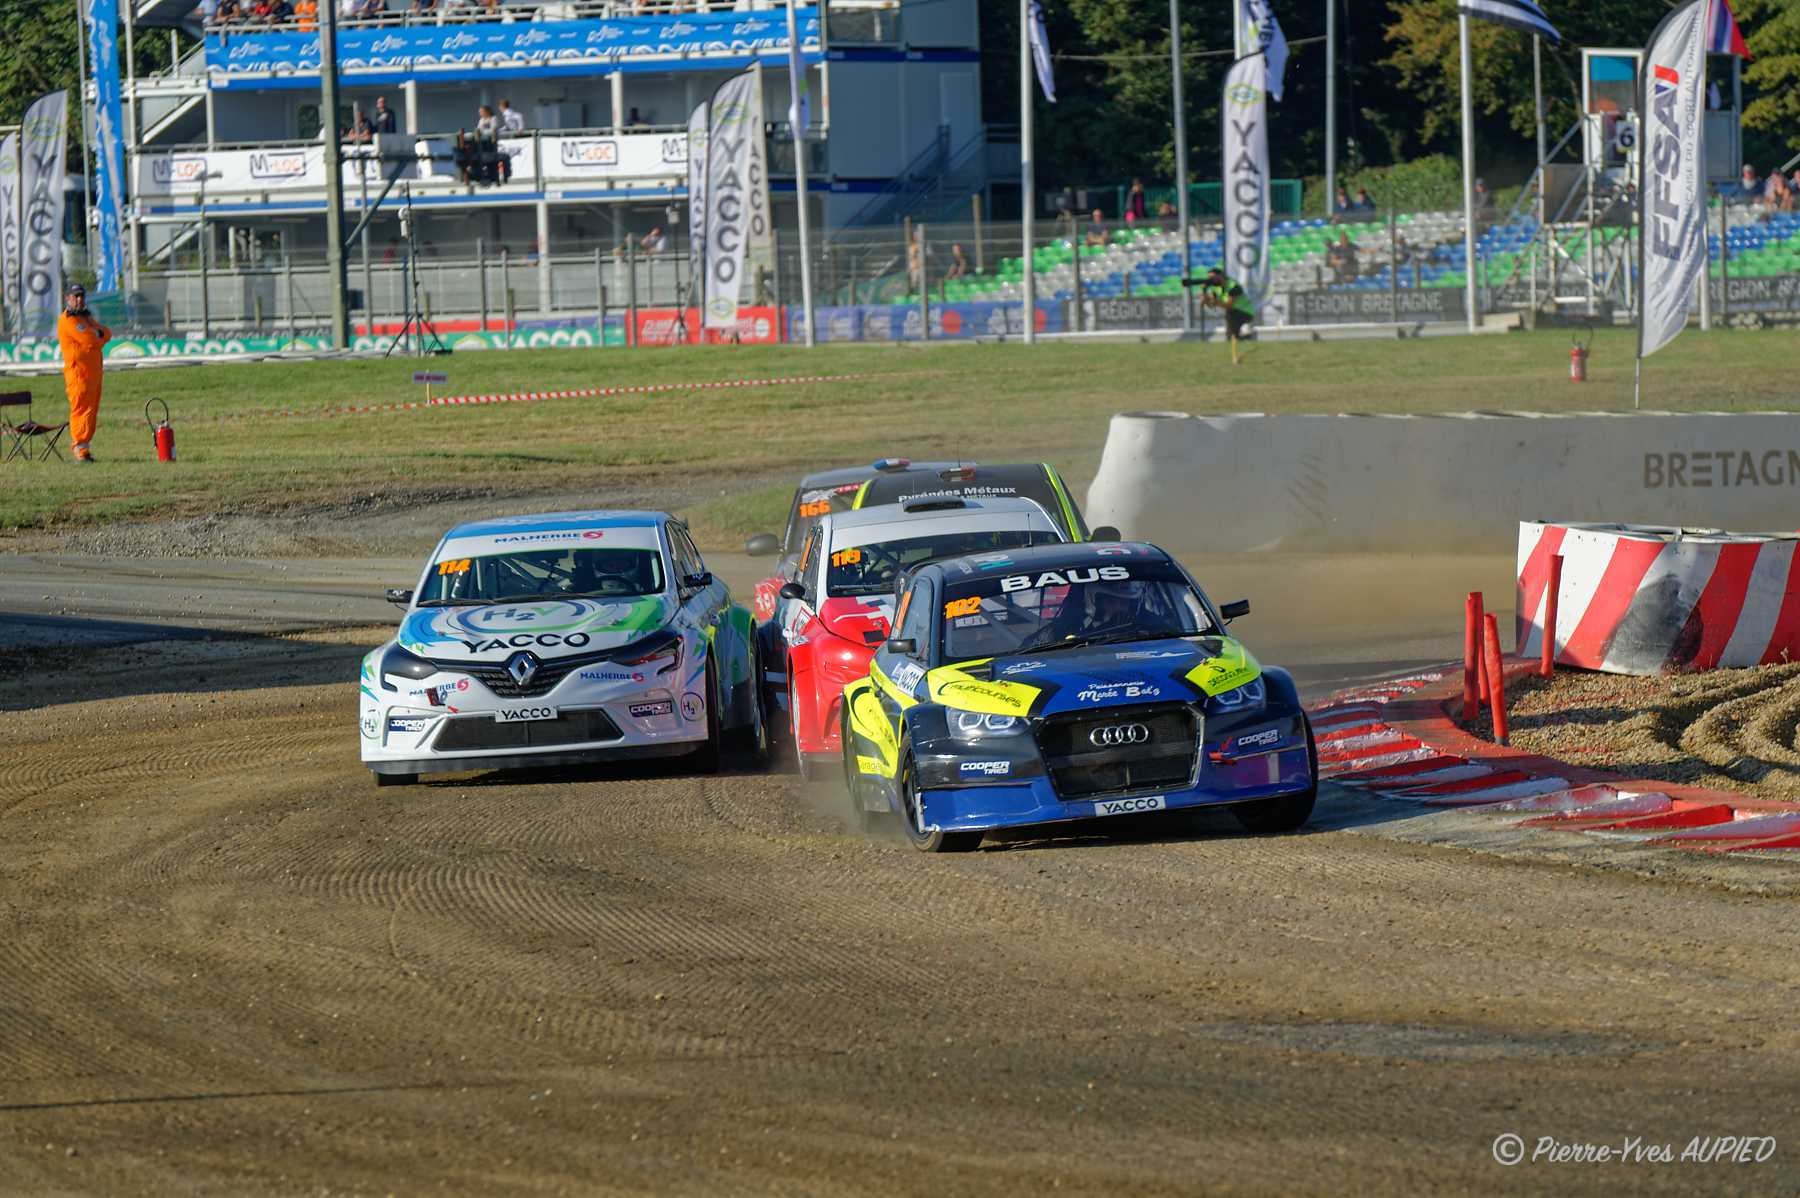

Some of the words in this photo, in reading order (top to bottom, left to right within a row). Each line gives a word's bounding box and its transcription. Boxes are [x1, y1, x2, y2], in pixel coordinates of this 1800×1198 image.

[1620, 129, 1635, 147] 6
[1653, 86, 1682, 262] FFSA
[1232, 119, 1260, 269] YACCO
[714, 137, 745, 283] YACCO
[28, 153, 57, 296] YACCO
[963, 485, 1016, 495] Métaux
[1000, 567, 1130, 593] BAUS
[460, 632, 591, 655] YACCO
[580, 672, 632, 680] MALHERBE
[502, 707, 552, 720] YACCO
[630, 701, 671, 713] COOPER
[1238, 729, 1279, 746] COOPER
[960, 761, 1010, 771] COOPER
[1102, 798, 1158, 815] YACCO
